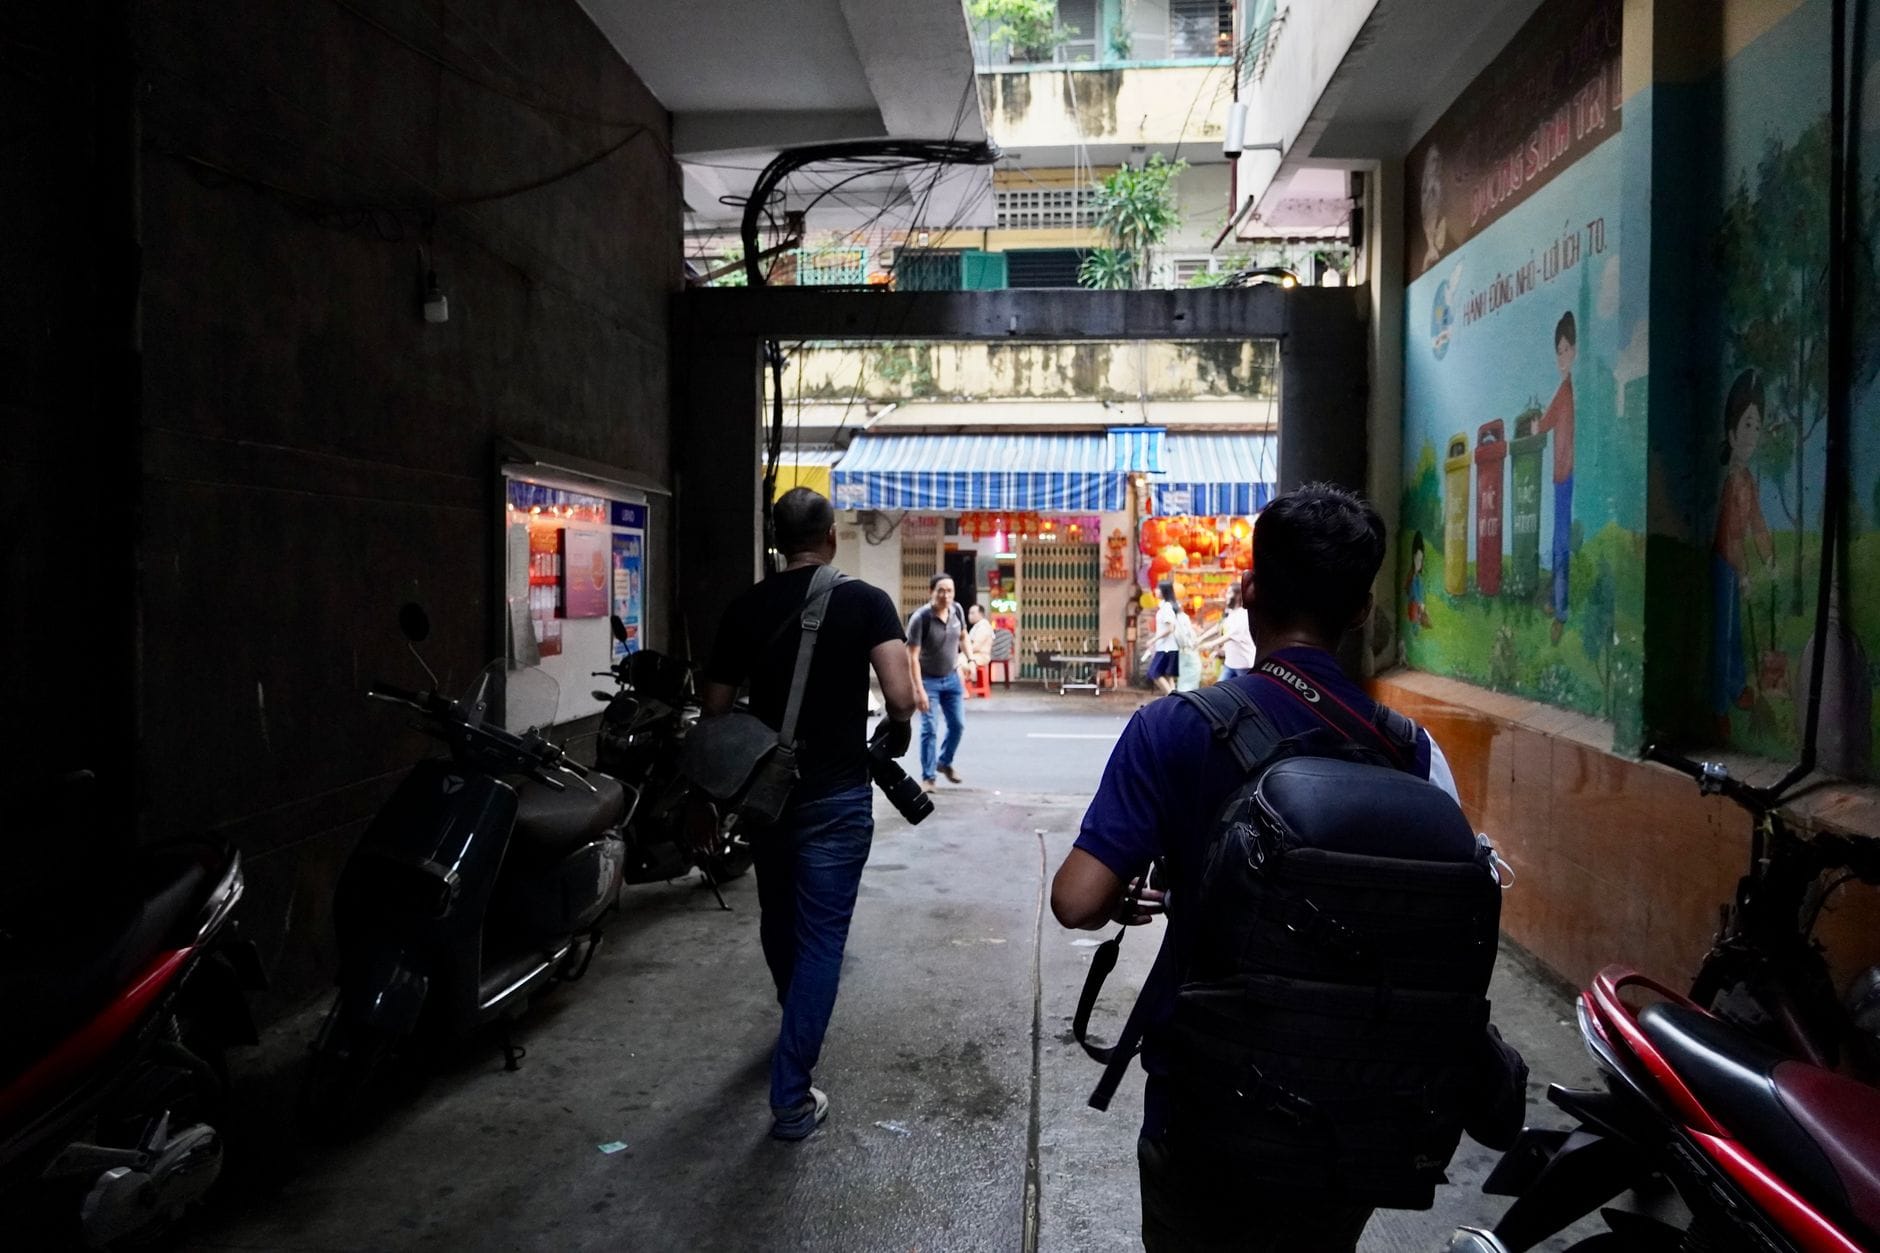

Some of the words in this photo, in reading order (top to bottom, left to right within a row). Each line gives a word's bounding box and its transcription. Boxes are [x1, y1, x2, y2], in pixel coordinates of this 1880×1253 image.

[1524, 101, 1570, 181] SINH
[1463, 287, 1488, 327] HÀNH
[1488, 271, 1514, 317] ĐỘNG
[1514, 248, 1536, 298] NHỎ
[1543, 238, 1560, 284] LỢI
[1562, 217, 1581, 271] ÍCH
[1586, 217, 1608, 258] TO.
[1260, 661, 1321, 703] Canon
